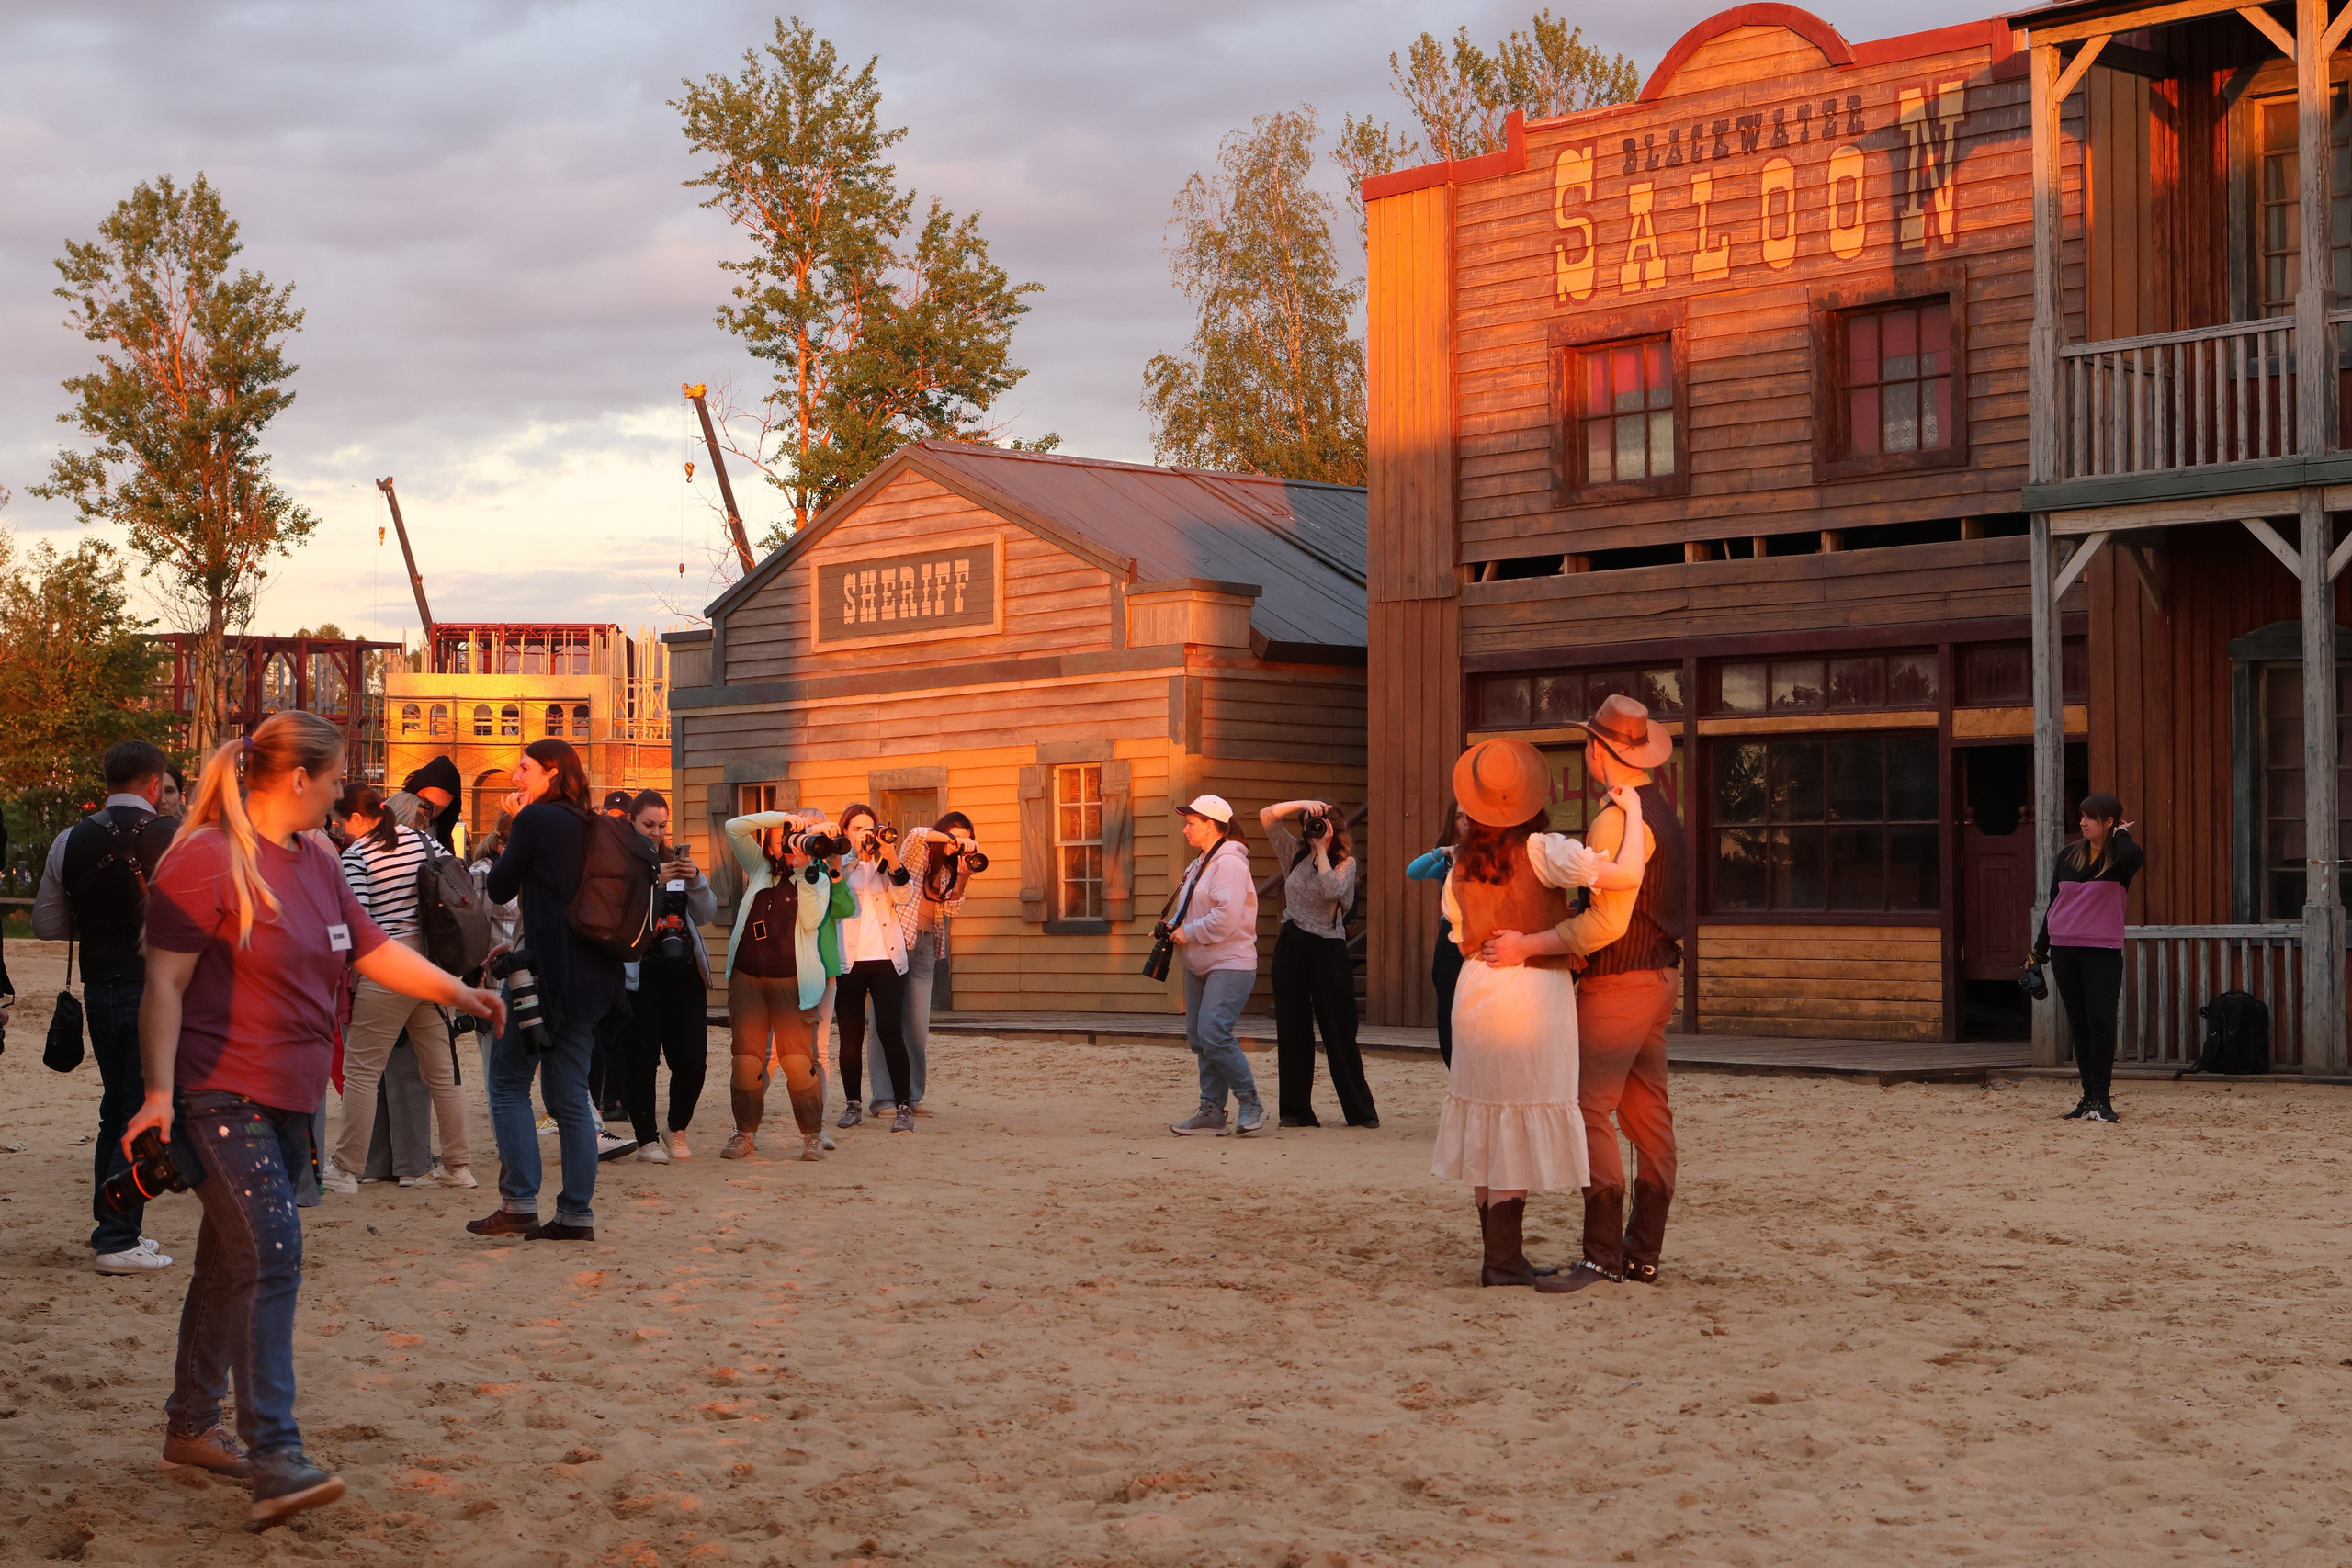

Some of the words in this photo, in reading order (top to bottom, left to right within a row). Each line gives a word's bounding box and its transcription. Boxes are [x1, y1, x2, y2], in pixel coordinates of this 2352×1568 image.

[1623, 94, 1866, 175] BLACKWATER
[1553, 73, 1971, 309] SALOON
[843, 558, 970, 625] SHERIFF
